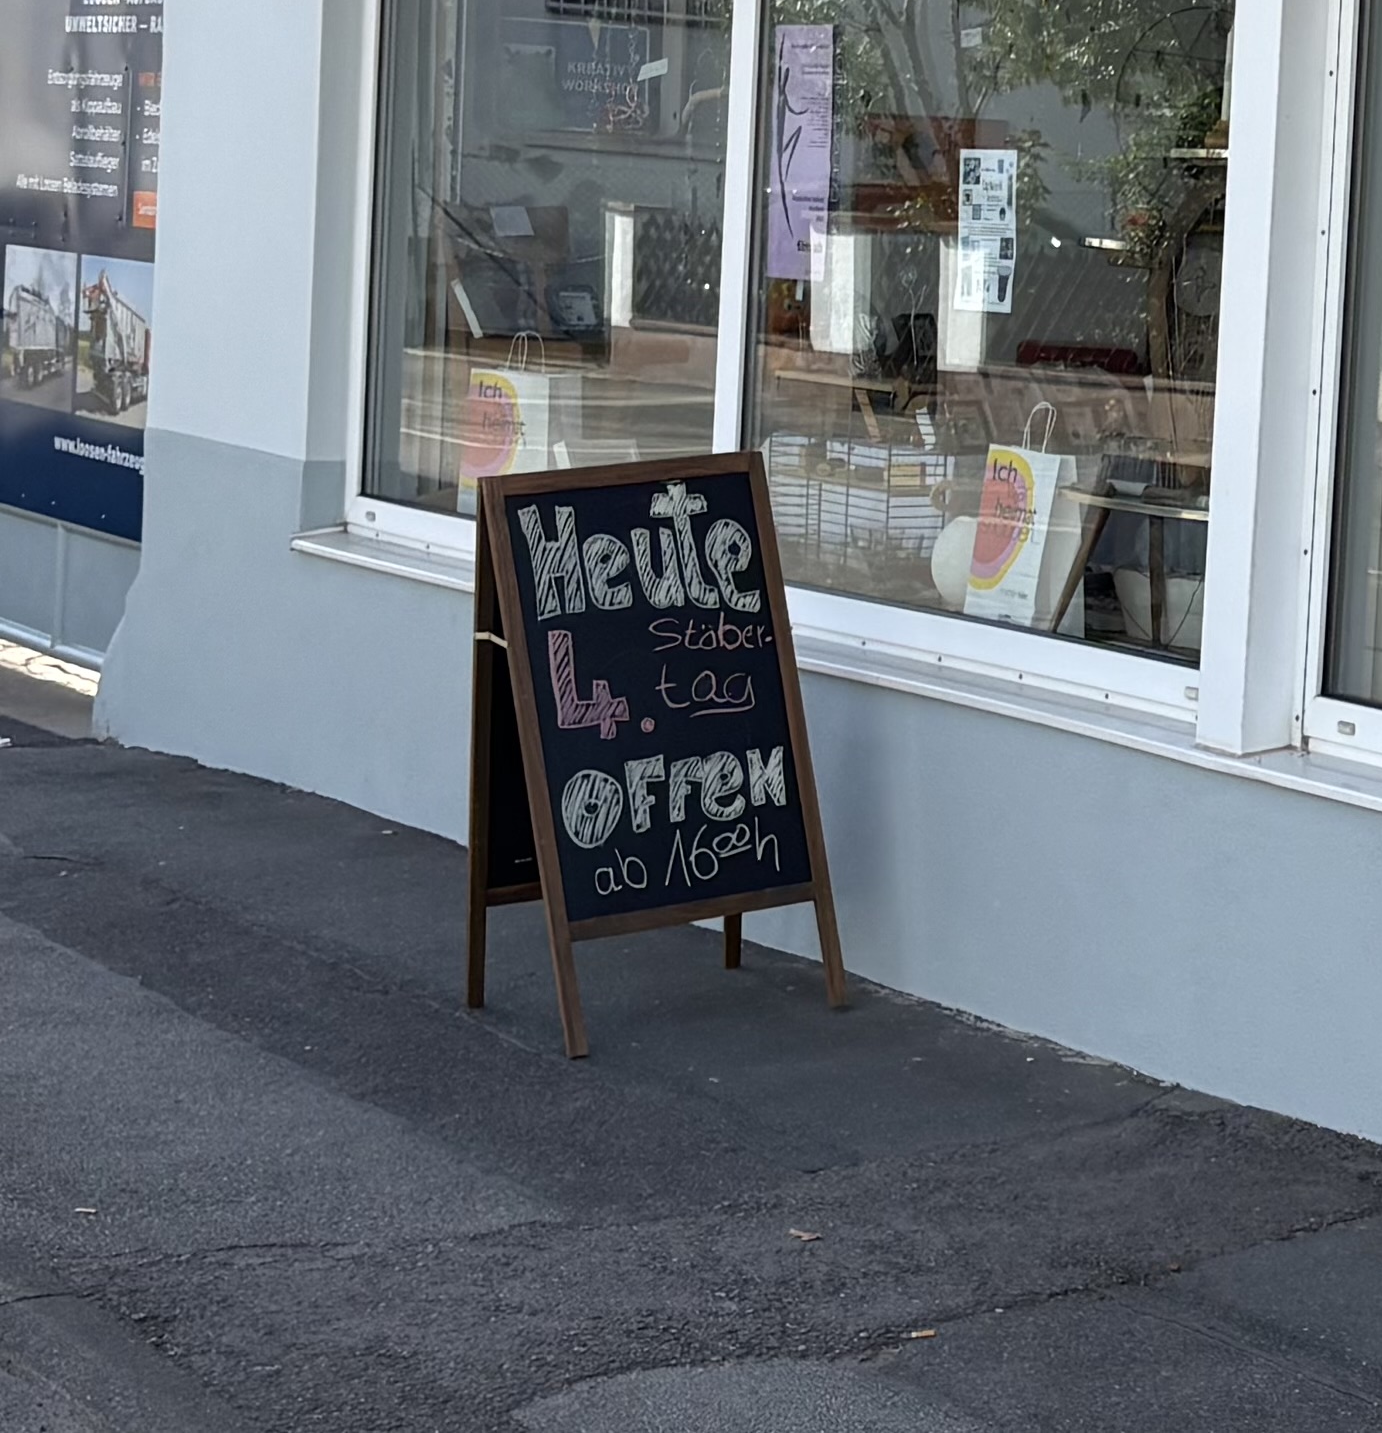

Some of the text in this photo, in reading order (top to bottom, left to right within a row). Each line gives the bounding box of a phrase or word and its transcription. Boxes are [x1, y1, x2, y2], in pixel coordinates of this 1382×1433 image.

[65, 15, 137, 33] UMWELTSICHER
[478, 380, 502, 398] Ich
[992, 458, 1018, 483] Ich
[517, 480, 760, 621] Heute
[548, 630, 655, 740] 4.
[655, 664, 756, 710] tag
[595, 848, 648, 895] ab
